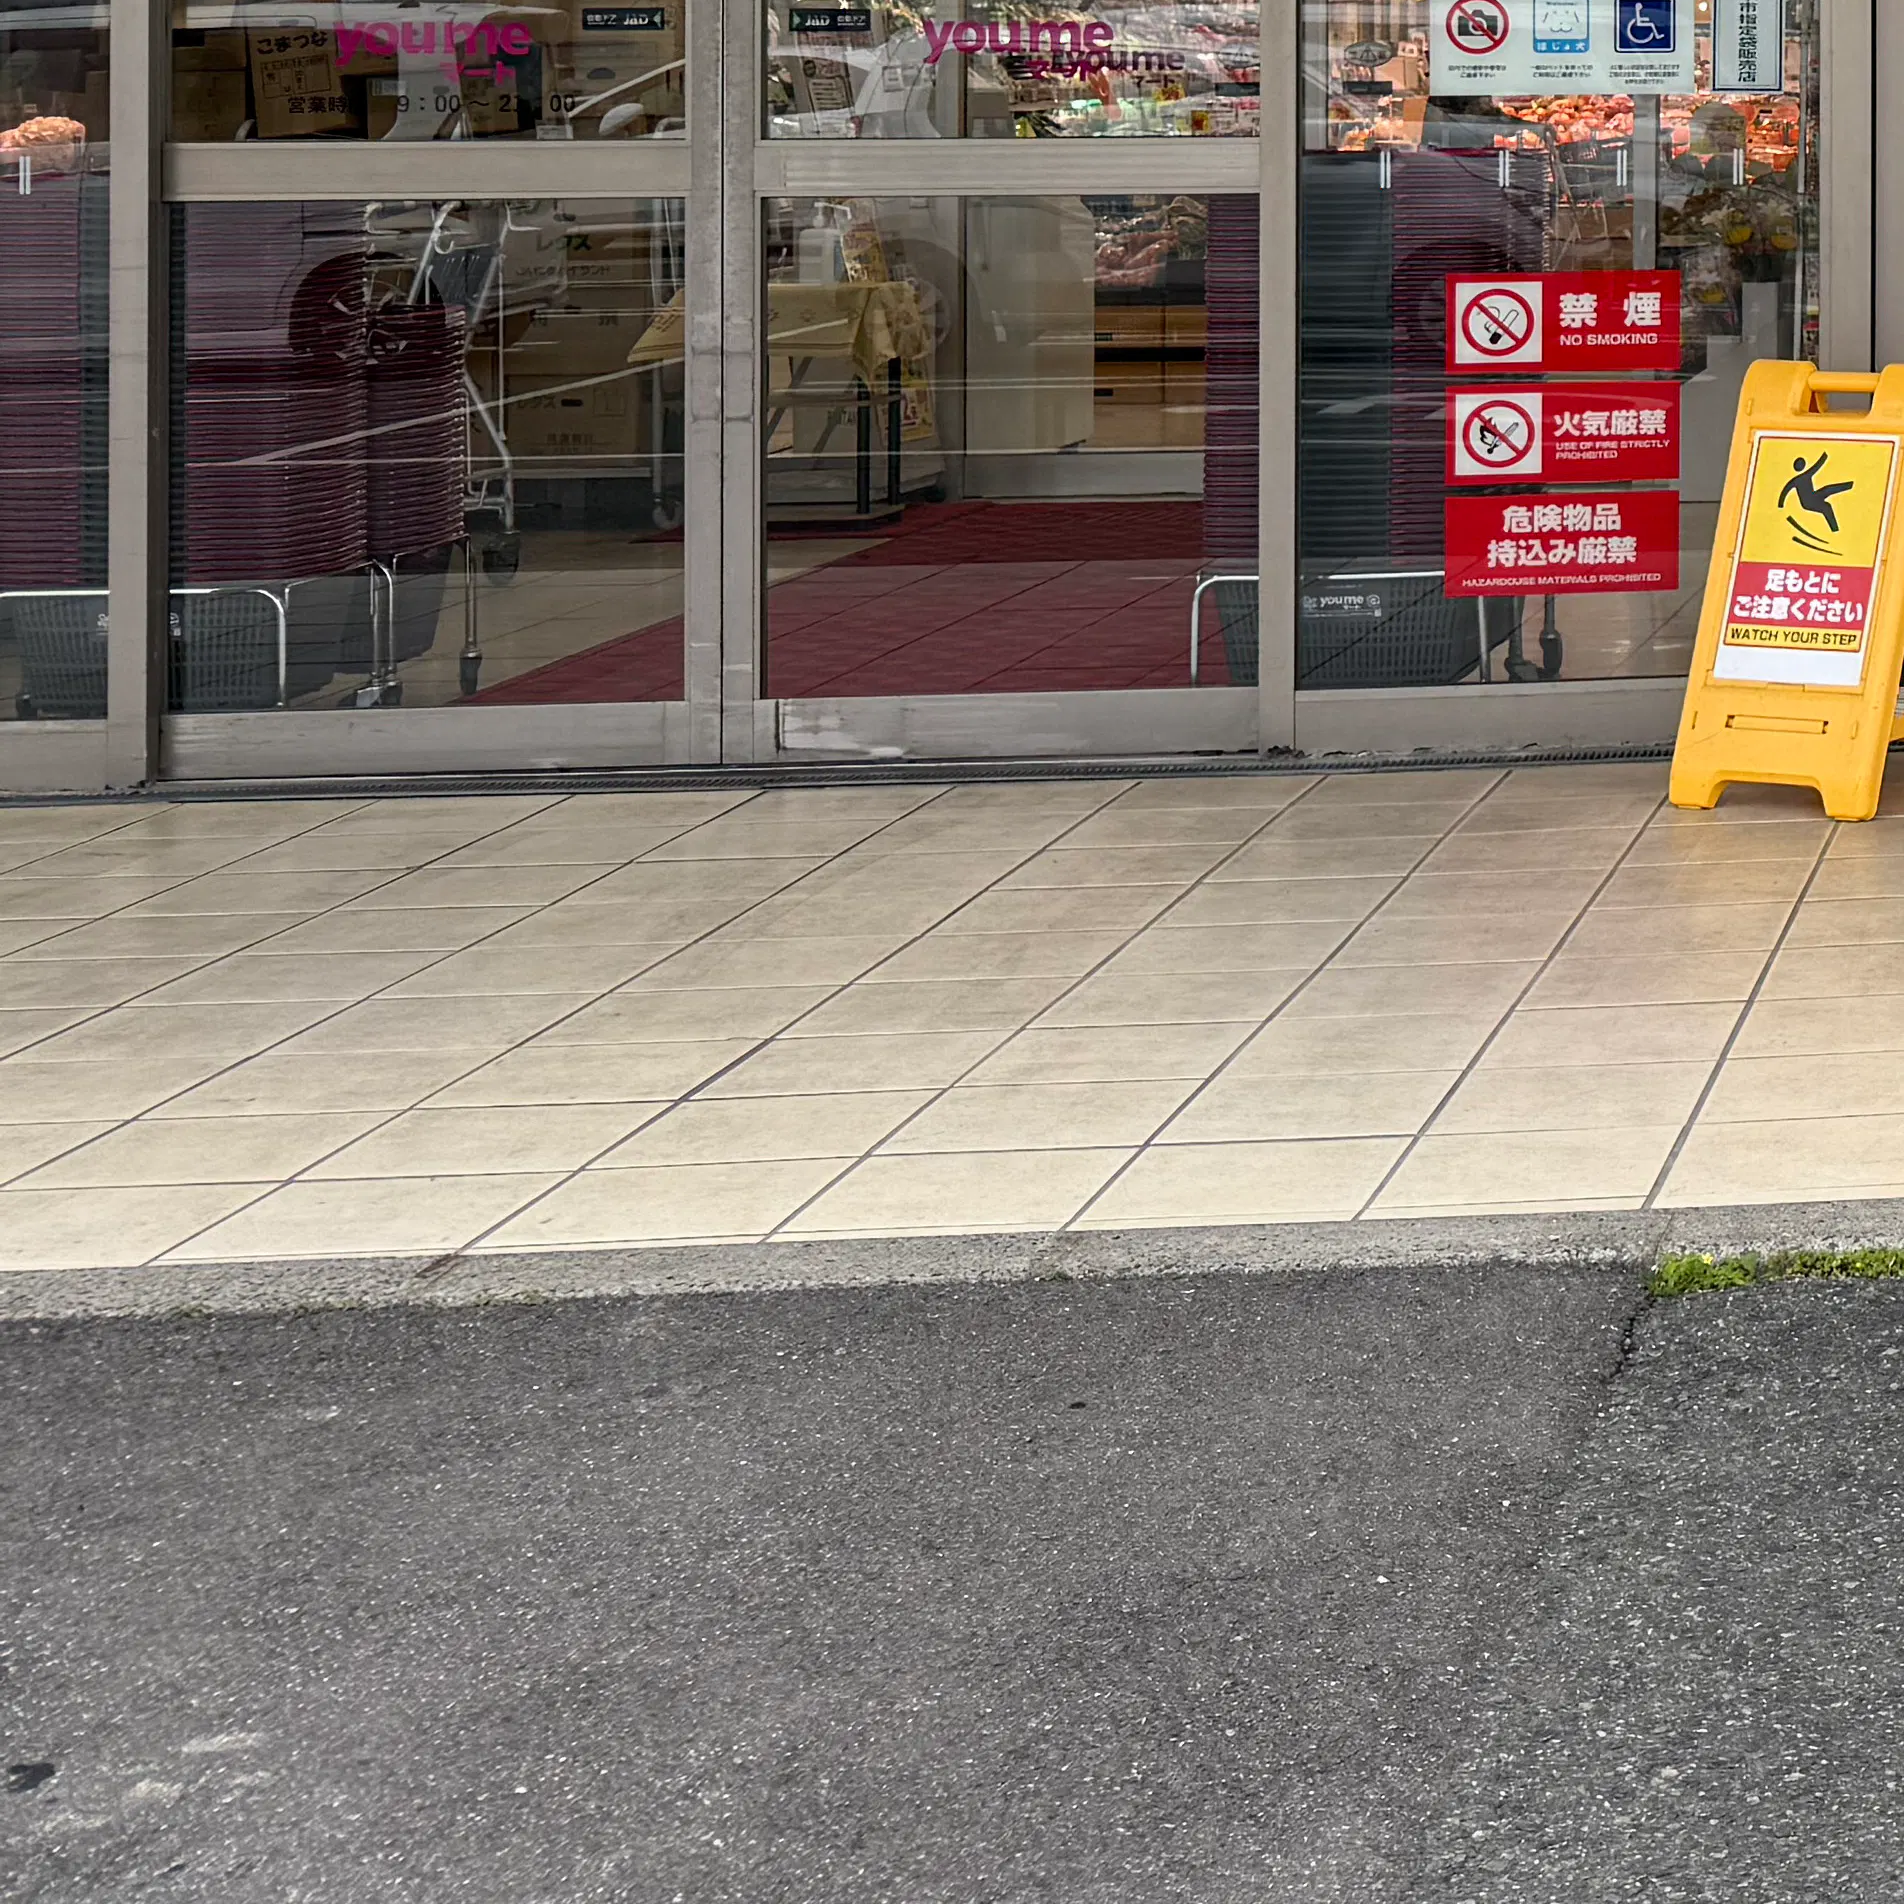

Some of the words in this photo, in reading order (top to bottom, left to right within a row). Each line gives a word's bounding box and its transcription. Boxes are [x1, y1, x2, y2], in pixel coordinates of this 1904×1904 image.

[256, 30, 329, 55] こまつな
[333, 20, 532, 68] youme
[922, 17, 1115, 64] youme
[287, 96, 363, 114] 営業時
[1558, 291, 1662, 328] 禁煙
[1560, 334, 1583, 346] NO
[1586, 333, 1658, 345] SMOKING
[1553, 409, 1667, 437] 火気厳禁
[1555, 450, 1618, 460] PROHIBITED
[1556, 441, 1578, 450] USE
[1579, 441, 1594, 450] OF
[1595, 441, 1619, 450] FIRE
[1620, 439, 1670, 449] STRICTLY
[1502, 503, 1622, 533] 危険物品
[1487, 536, 1637, 568] 持込み厳禁
[1537, 574, 1598, 585] MATERIALS
[1599, 573, 1662, 583] PROHIBITED
[1765, 569, 1841, 594] 足もとに
[1733, 595, 1864, 623] ご注意ください
[1731, 627, 1779, 642] WATCH
[1783, 630, 1819, 644] YOUR
[1822, 632, 1857, 645] STEP
